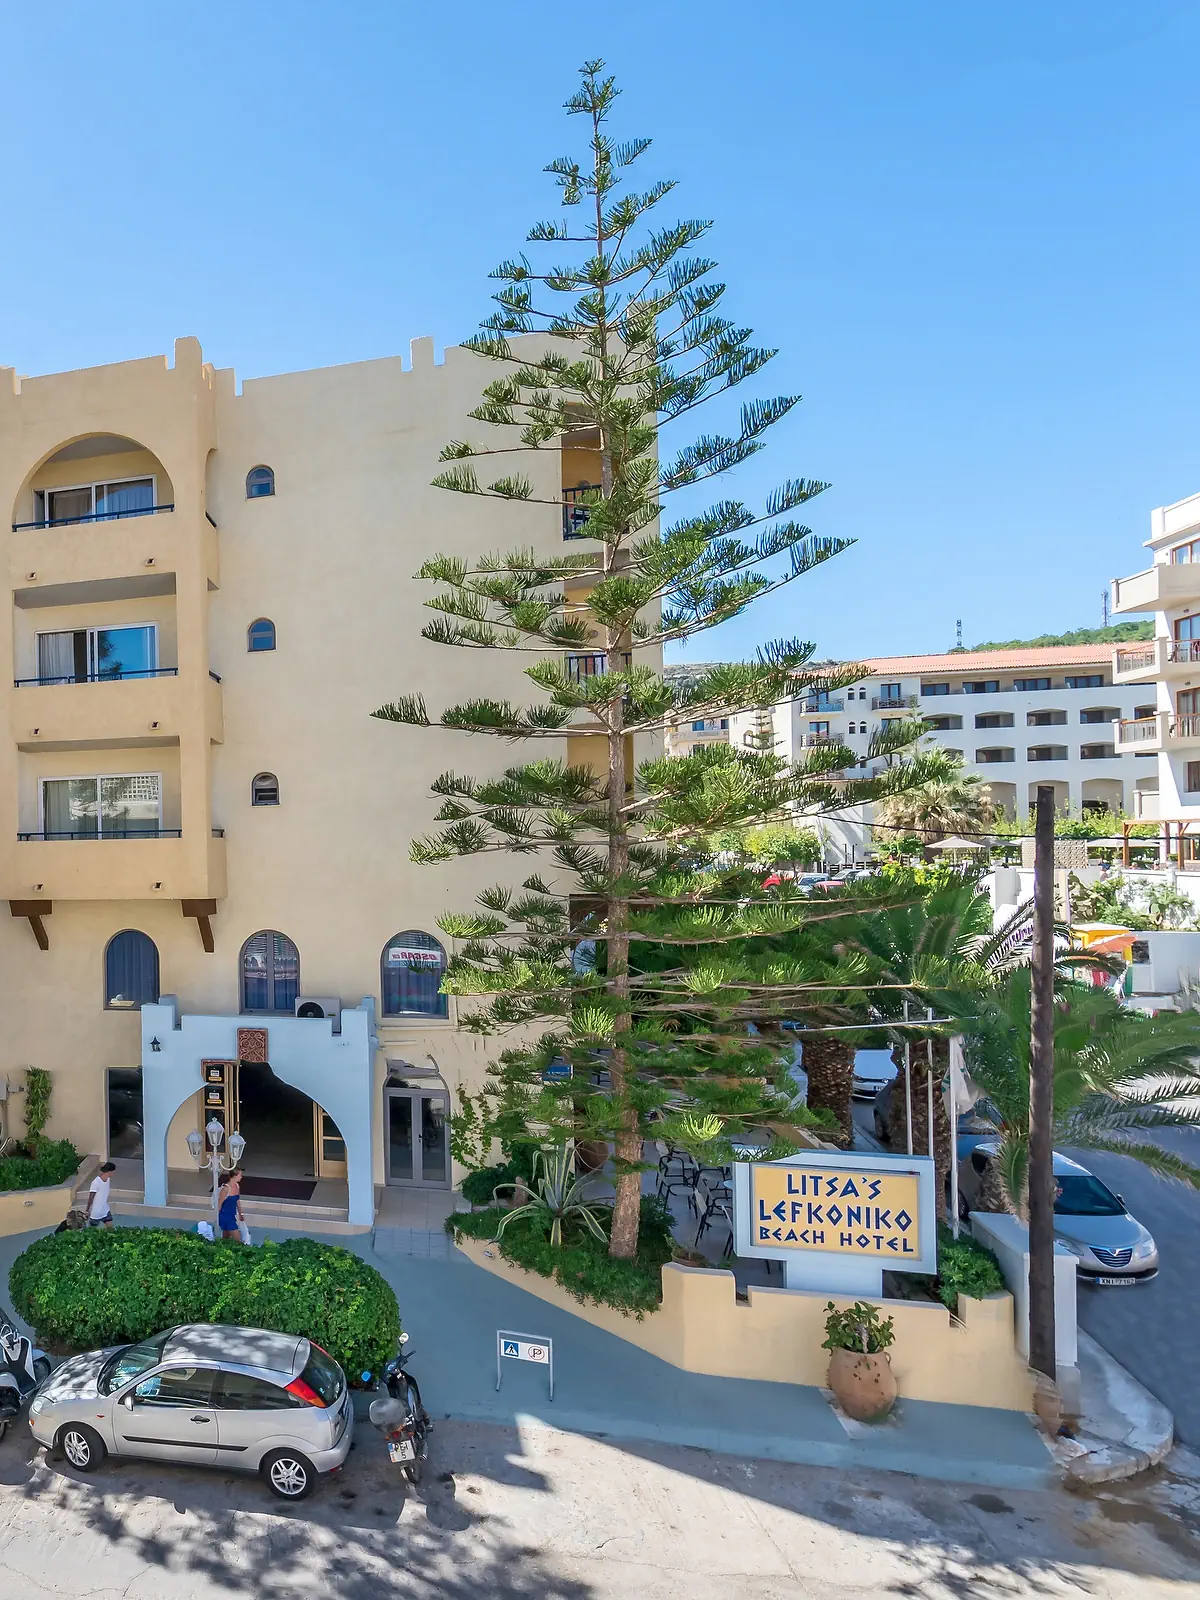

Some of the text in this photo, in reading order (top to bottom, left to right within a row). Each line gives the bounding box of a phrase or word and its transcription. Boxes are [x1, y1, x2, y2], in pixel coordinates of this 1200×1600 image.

[787, 1173, 882, 1201] LITSA'S
[759, 1199, 913, 1232] LEFKONIKO
[759, 1226, 914, 1253] BEACH HOTEL
